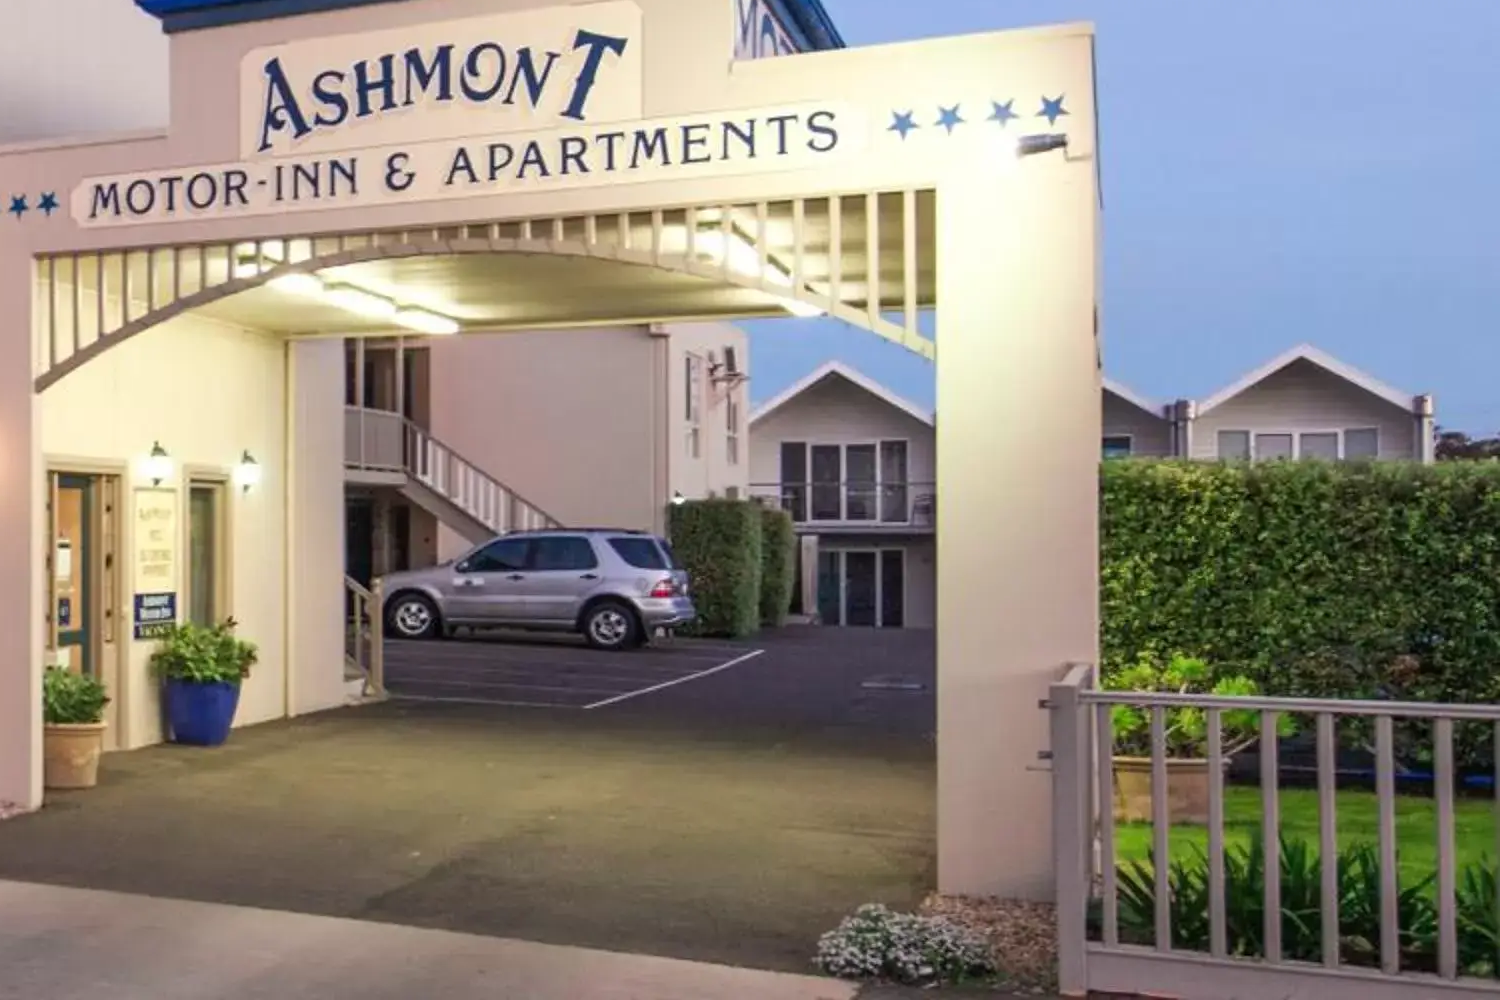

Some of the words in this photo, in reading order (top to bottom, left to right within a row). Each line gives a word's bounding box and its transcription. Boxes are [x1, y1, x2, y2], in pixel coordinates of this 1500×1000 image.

[257, 28, 629, 152] ASHMONT
[88, 157, 358, 219] MOTOR-INN
[384, 151, 416, 192] &
[445, 110, 840, 186] APARTMENTS
